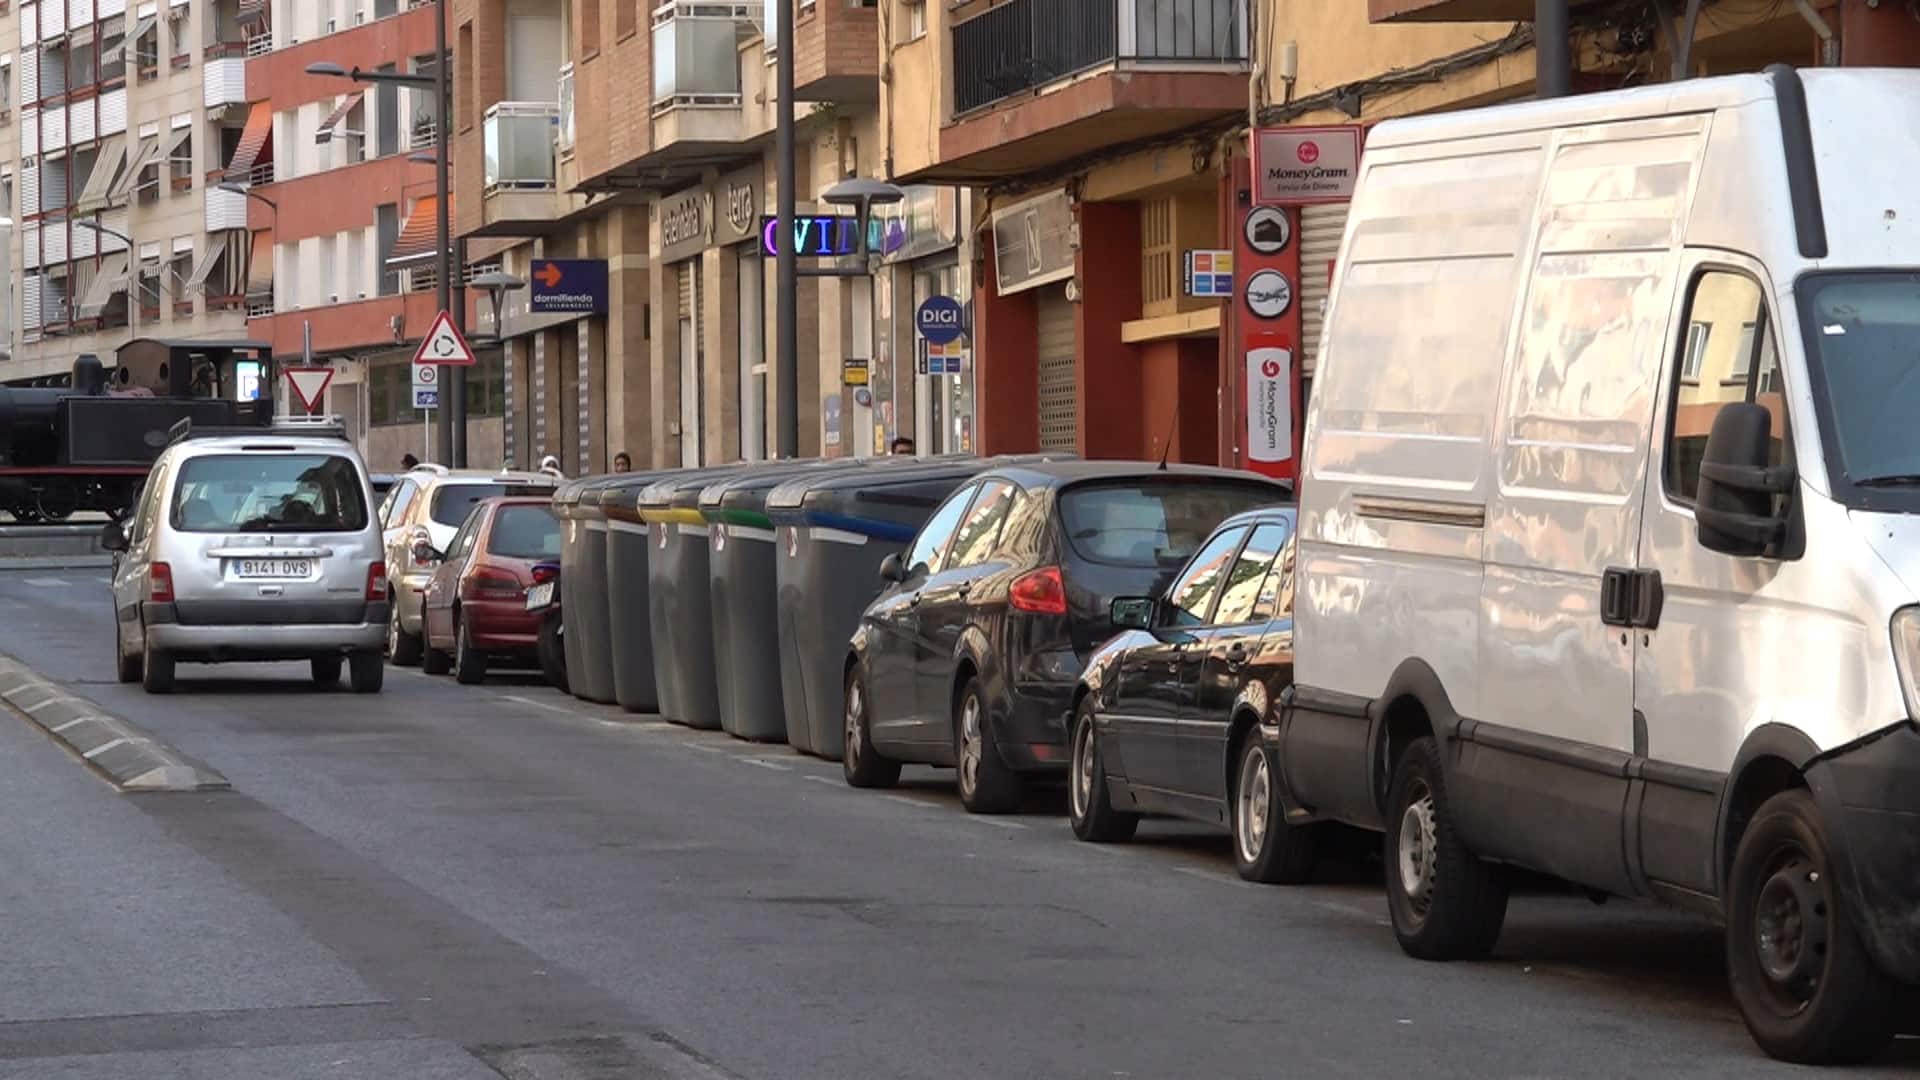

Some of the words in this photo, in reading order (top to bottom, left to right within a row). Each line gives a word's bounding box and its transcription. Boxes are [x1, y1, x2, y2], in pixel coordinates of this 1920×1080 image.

[1269, 166, 1347, 180] MoneyGram
[727, 184, 752, 222] terra
[534, 293, 592, 303] dormitienda
[922, 310, 957, 322] DIGI
[1265, 380, 1277, 449] MoneyGram
[244, 561, 275, 574] 9141
[282, 560, 307, 574] DVS
